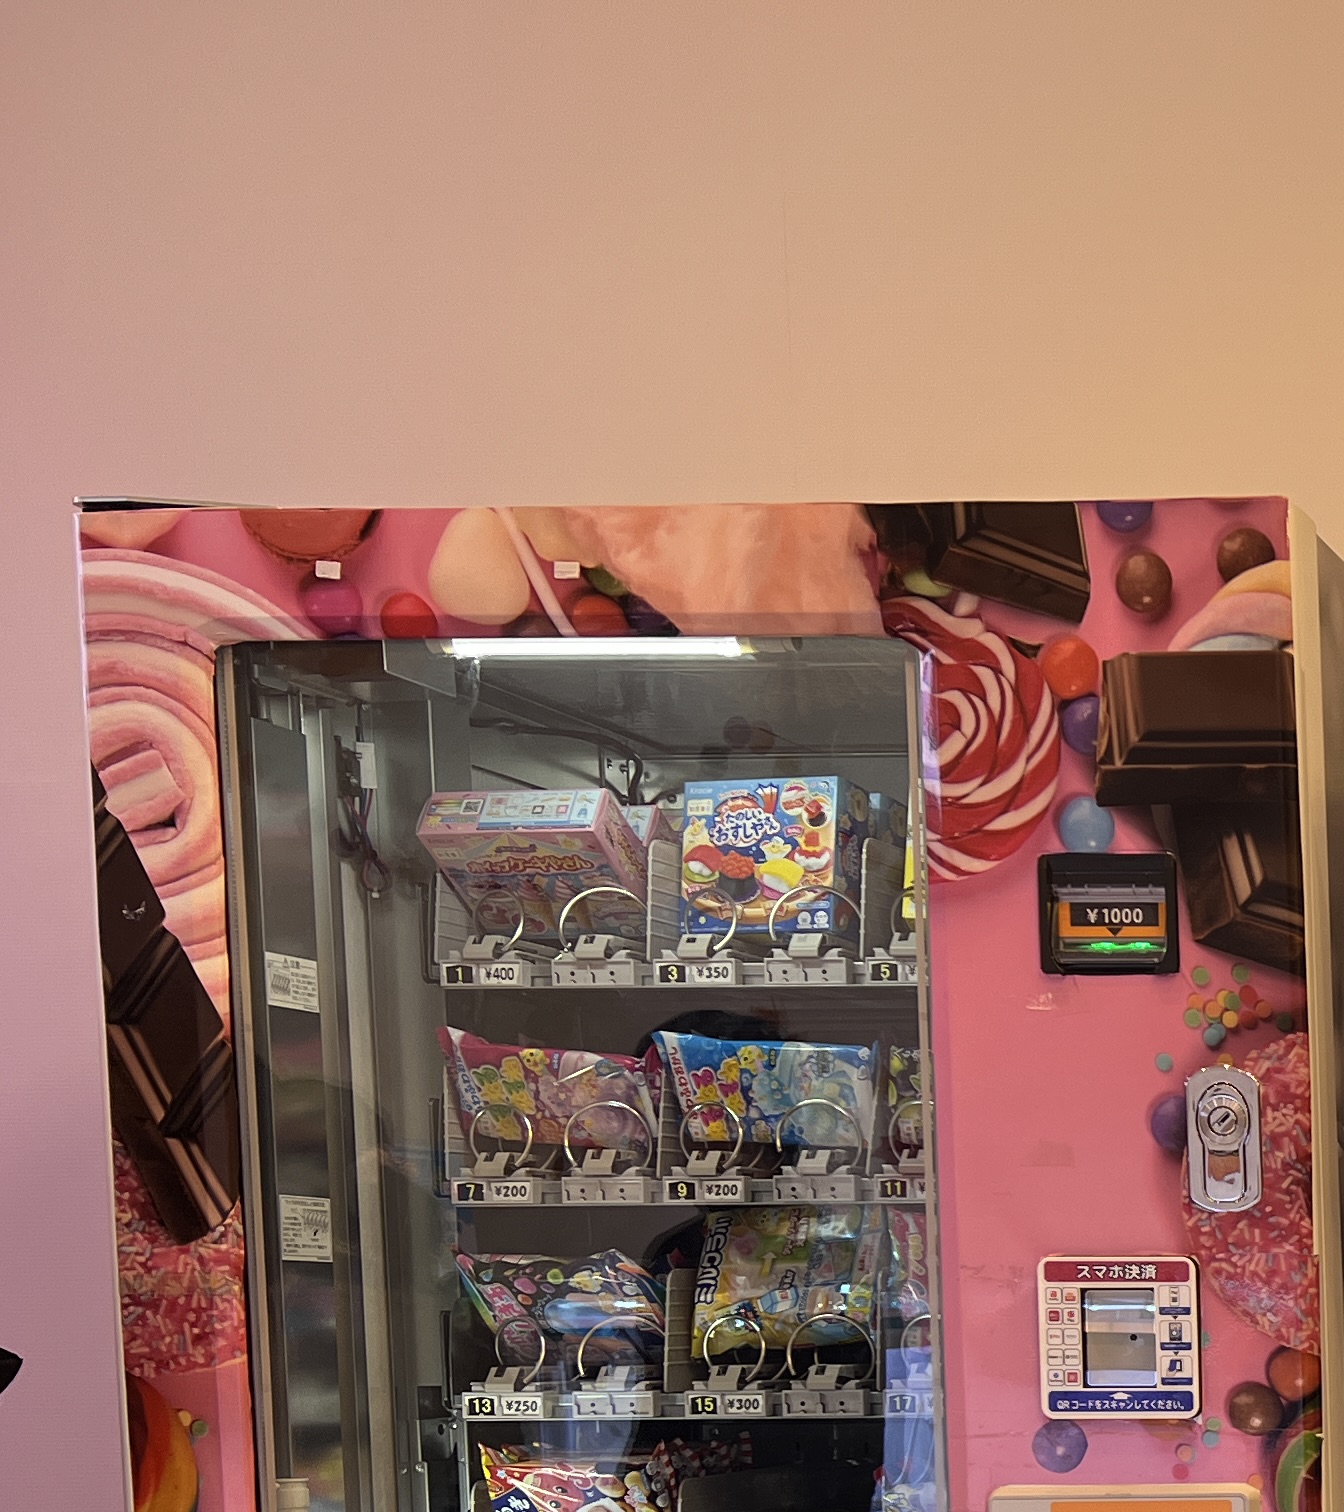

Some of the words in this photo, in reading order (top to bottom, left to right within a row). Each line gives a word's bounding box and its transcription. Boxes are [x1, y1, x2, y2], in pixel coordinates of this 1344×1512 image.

[725, 809, 762, 823] たのしい
[715, 817, 780, 842] おすしやさん
[1086, 907, 1143, 924] ¥1000
[454, 967, 463, 983] 1
[485, 965, 515, 982] ¥400
[668, 965, 678, 982] 3
[695, 965, 729, 981] ¥350
[880, 963, 890, 980] 5
[465, 1184, 476, 1200] 7
[495, 1184, 527, 1198] ¥200
[677, 1183, 687, 1198] 9
[706, 1183, 739, 1197] ¥200
[884, 1181, 902, 1196] 11
[1076, 1264, 1157, 1281] スマホ決済
[472, 1398, 492, 1414] 13
[505, 1399, 538, 1413] ¥250
[695, 1396, 714, 1413] 15
[728, 1397, 760, 1411] ¥300
[1056, 1399, 1186, 1412] QRコードをスキャンしてください。
